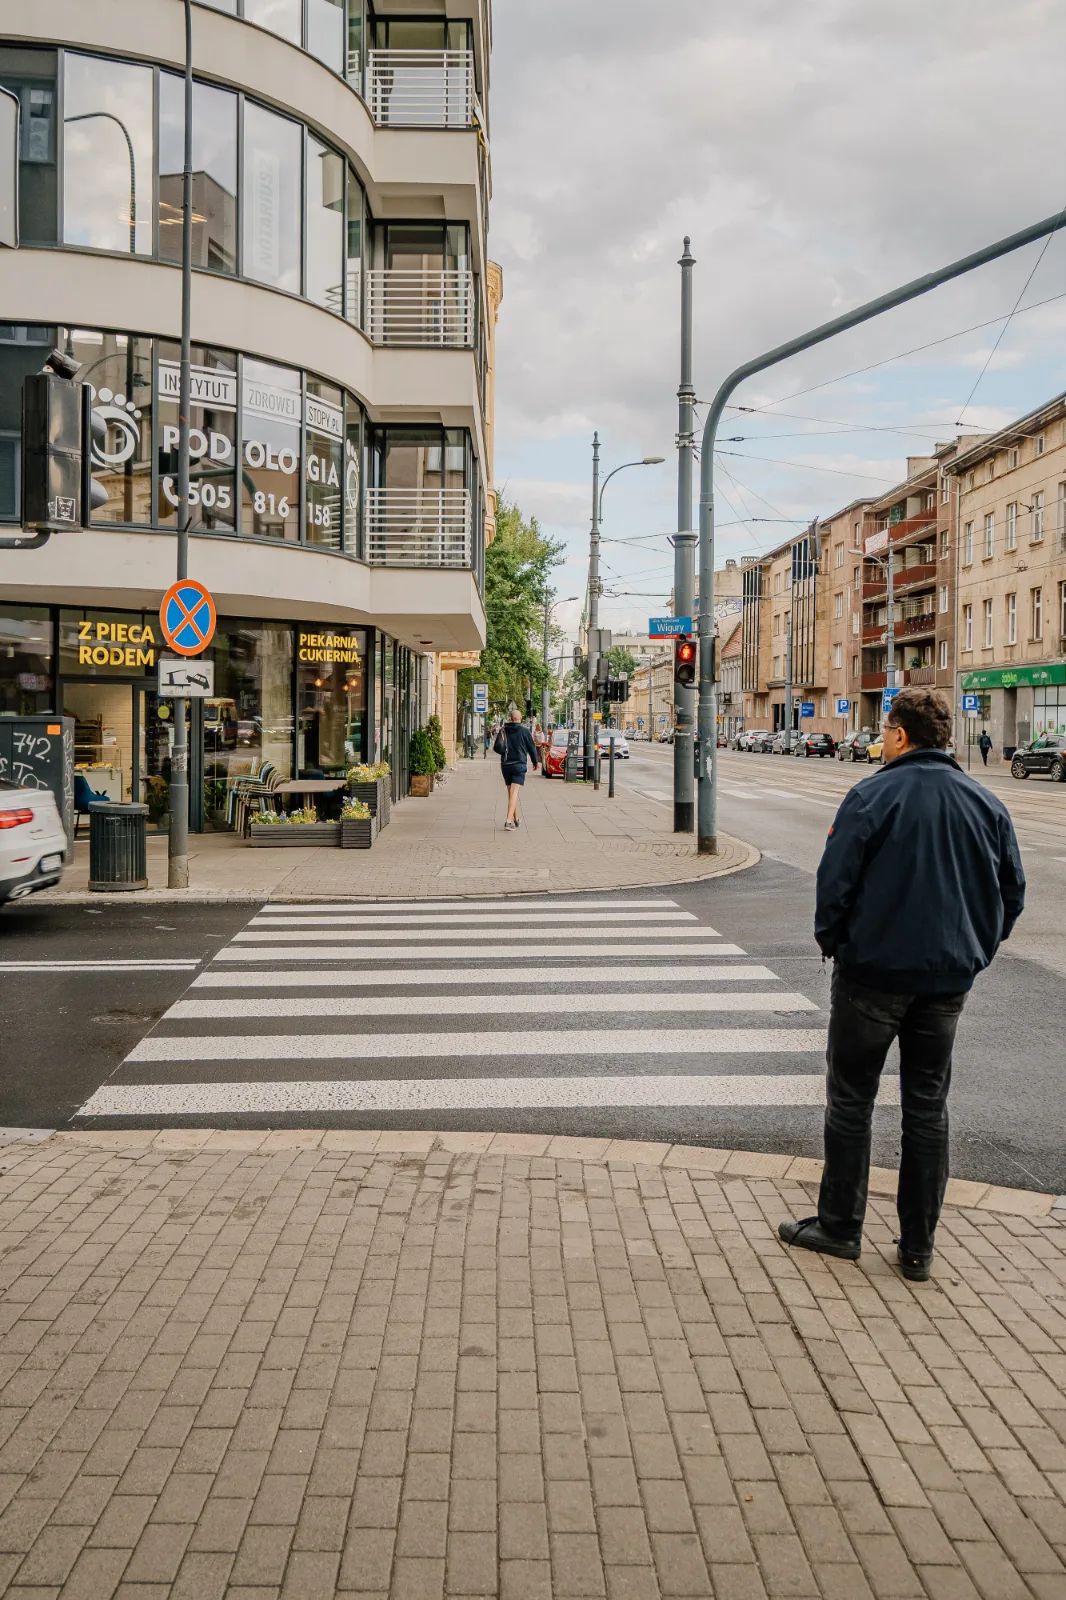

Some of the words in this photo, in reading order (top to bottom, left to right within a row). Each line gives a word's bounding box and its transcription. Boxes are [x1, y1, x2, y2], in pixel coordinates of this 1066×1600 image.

[165, 373, 229, 400] INTYTUT
[249, 389, 295, 415] ZDROWEJ
[187, 481, 231, 509] 505
[254, 491, 290, 518] 816
[307, 502, 330, 527] 158
[78, 621, 92, 640] Z
[96, 622, 155, 643] PIECA
[657, 623, 685, 634] Wigury
[299, 633, 359, 649] PIEKARNIA
[79, 645, 155, 667] RODEM
[299, 648, 359, 662] CUKIERNIA
